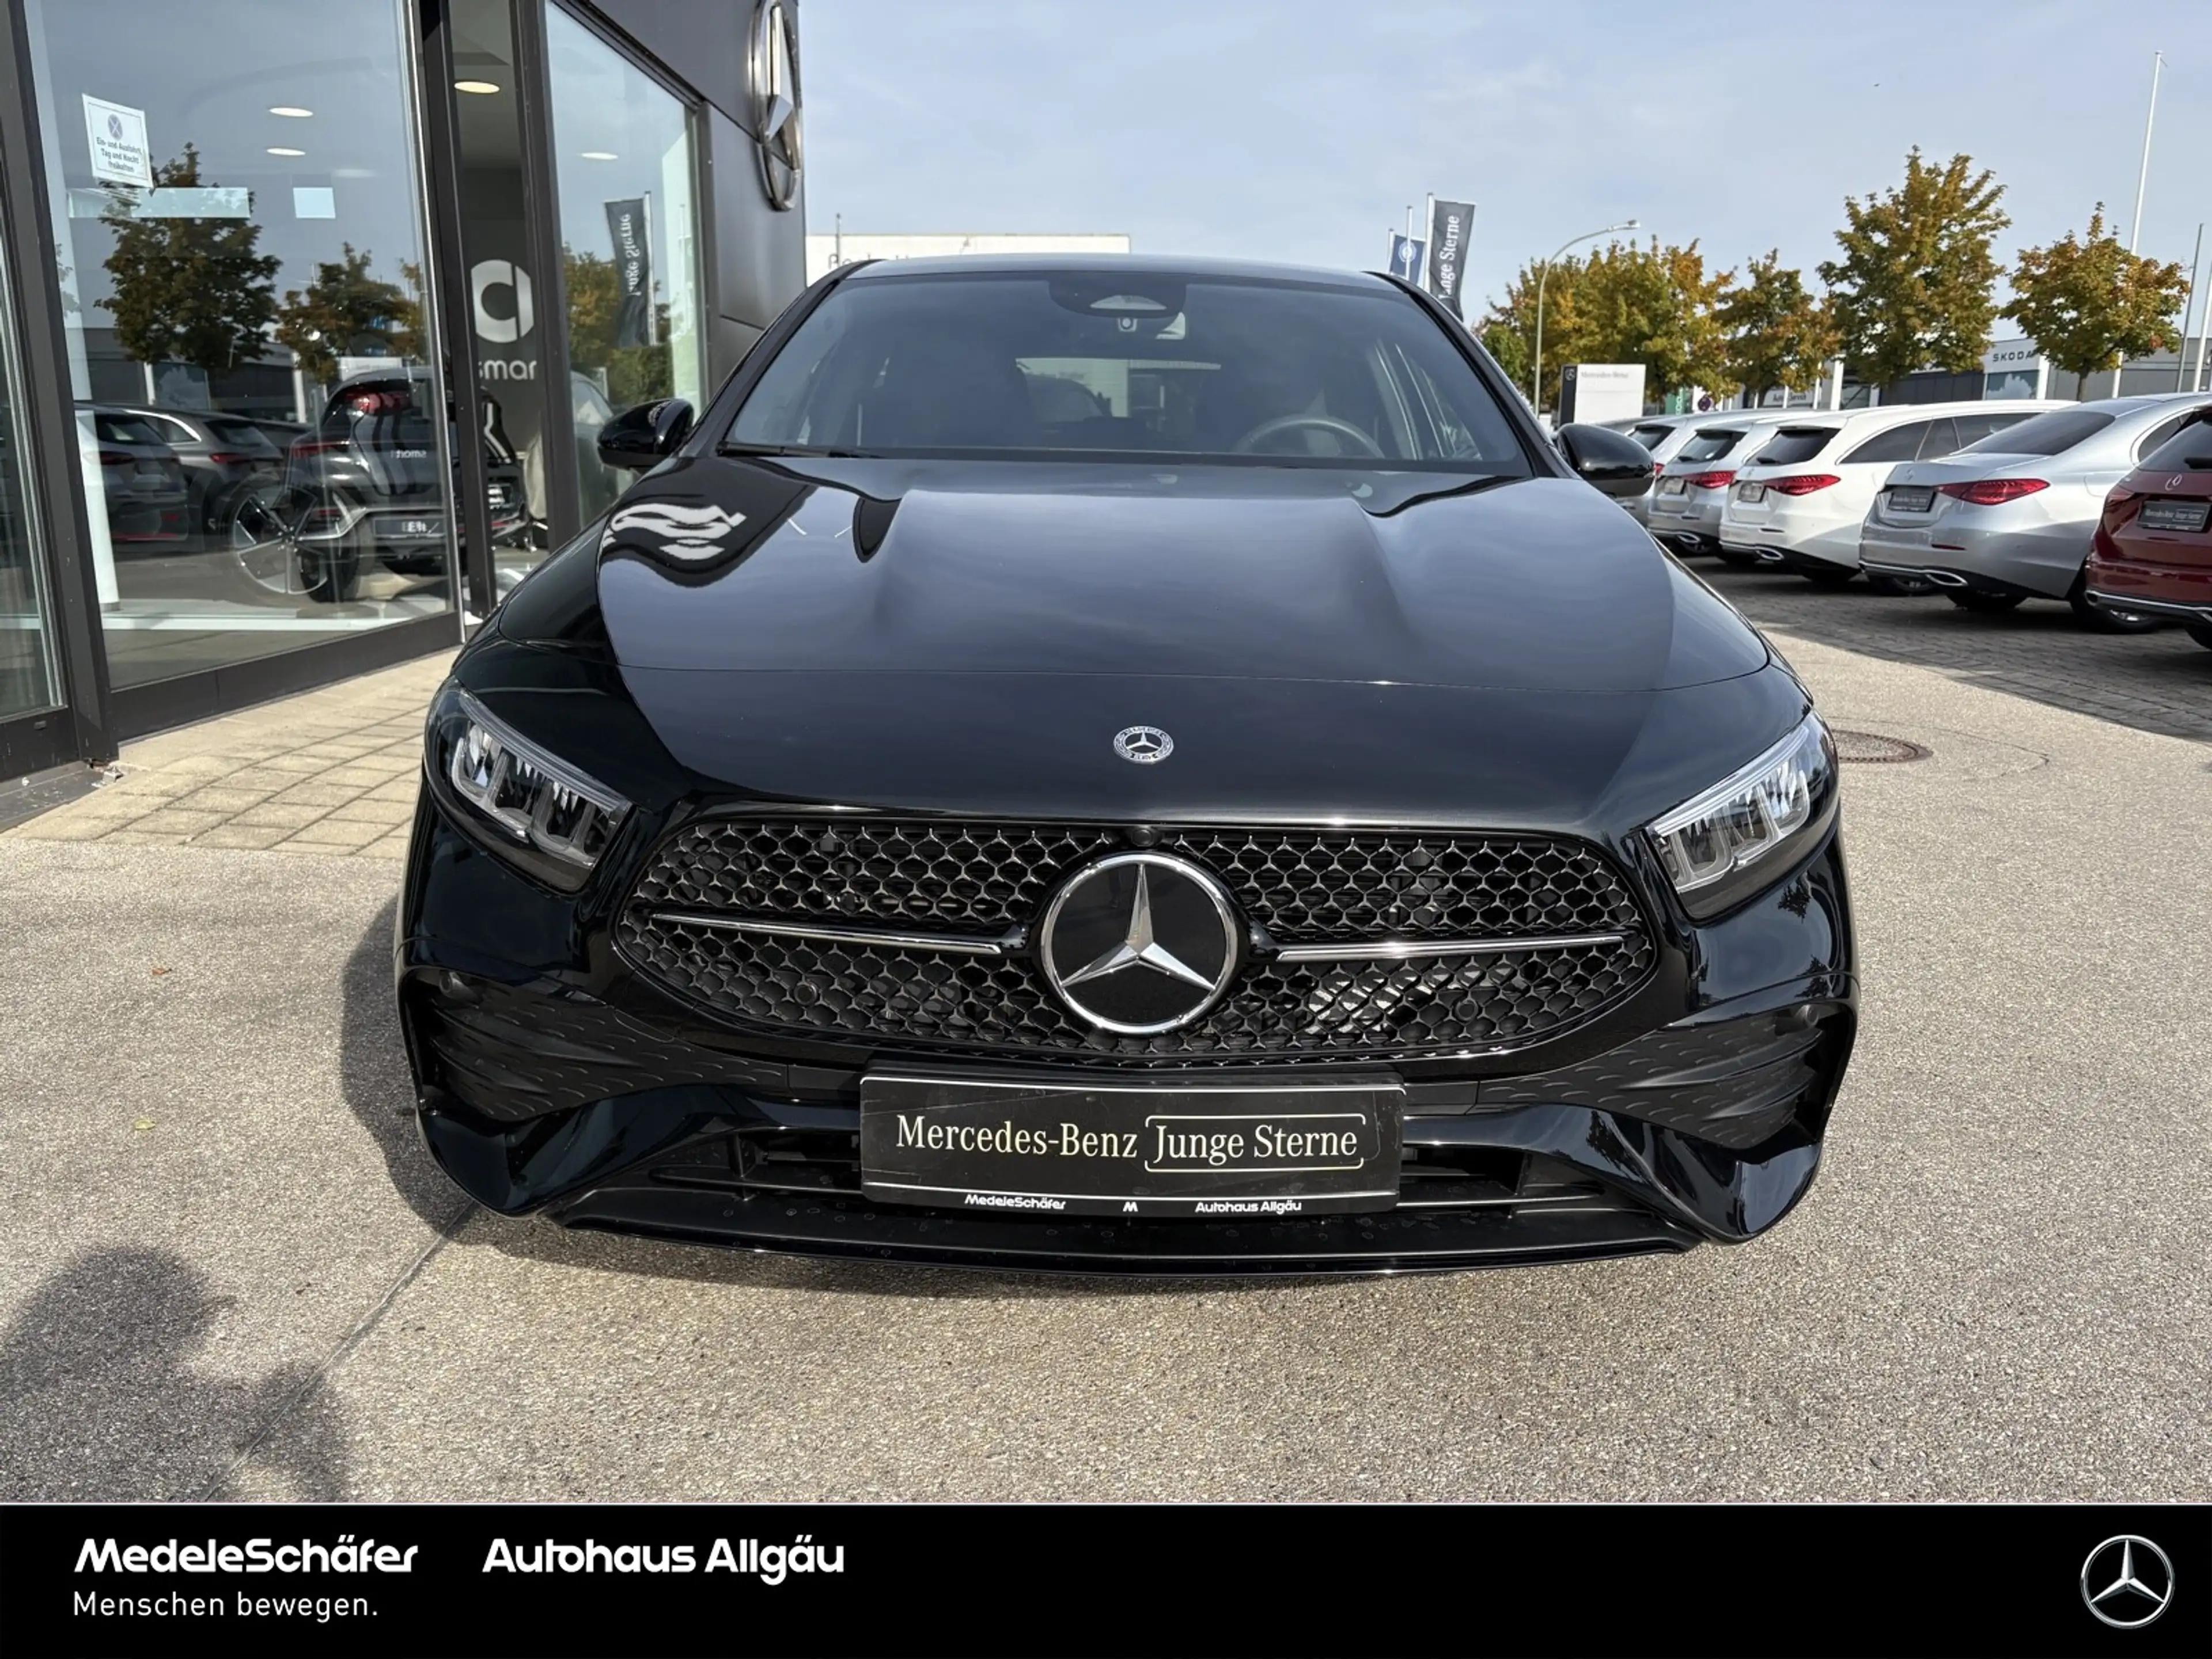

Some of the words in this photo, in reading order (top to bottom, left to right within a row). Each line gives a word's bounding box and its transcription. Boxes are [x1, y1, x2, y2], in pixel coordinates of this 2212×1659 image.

[1440, 215, 1460, 261] Sterne
[896, 1115, 1138, 1158] Mercedes-Benz
[1153, 1125, 1244, 1166] Junge
[1253, 1124, 1358, 1158] Sterne
[964, 1194, 1066, 1210] MedeleSchäfer
[1195, 1202, 1259, 1213] Autohaus
[1260, 1199, 1302, 1215] Allgäu
